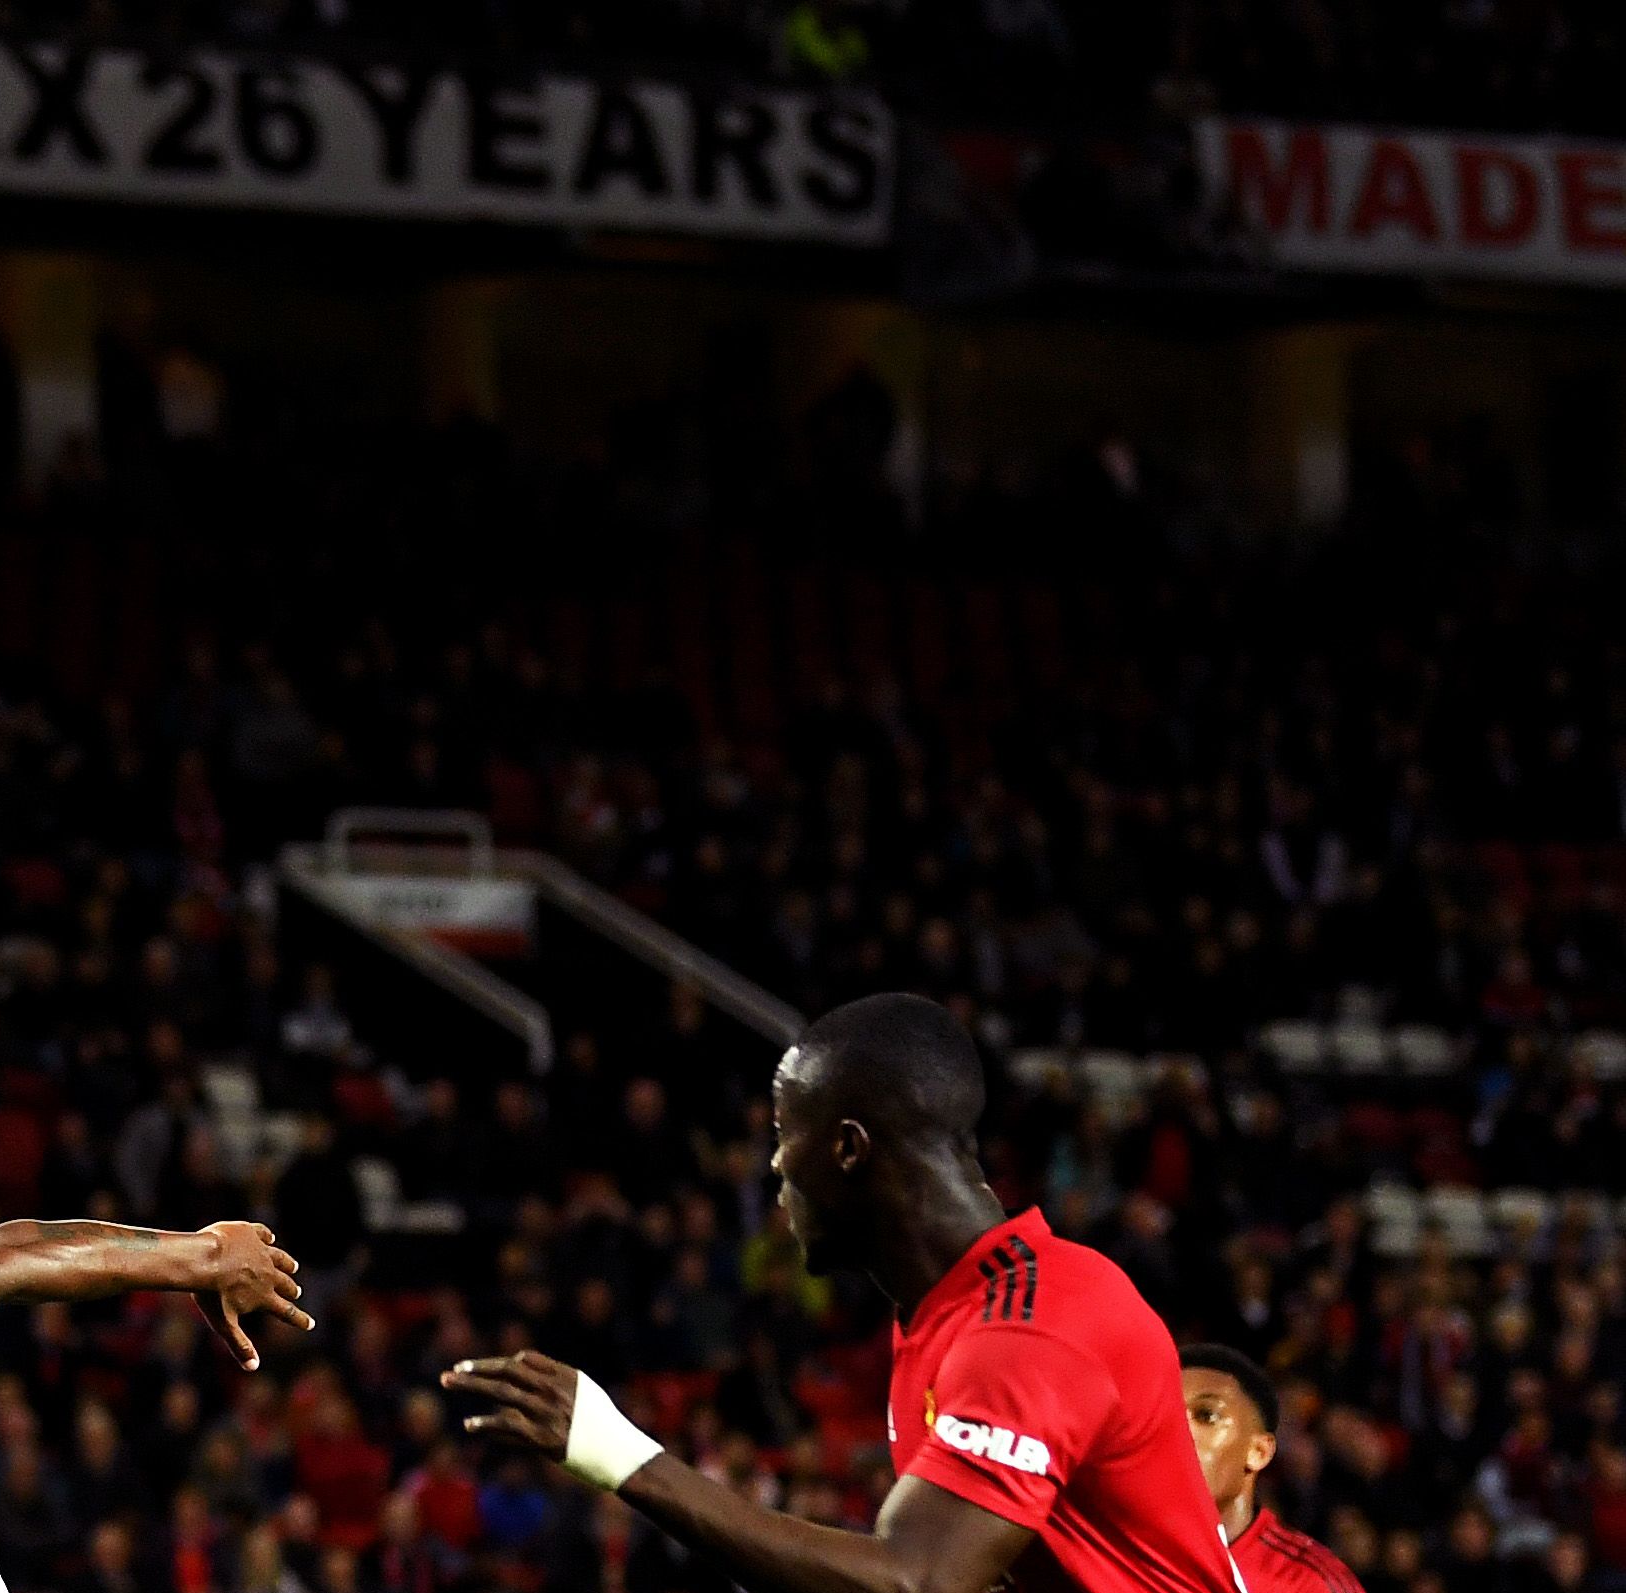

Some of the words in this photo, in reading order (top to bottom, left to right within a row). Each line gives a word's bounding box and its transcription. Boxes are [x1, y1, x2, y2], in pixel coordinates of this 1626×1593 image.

[145, 68, 315, 173] 26
[353, 66, 877, 210] YEARS
[1227, 128, 1626, 250] MADE
[935, 1414, 1051, 1476] KOHLER
